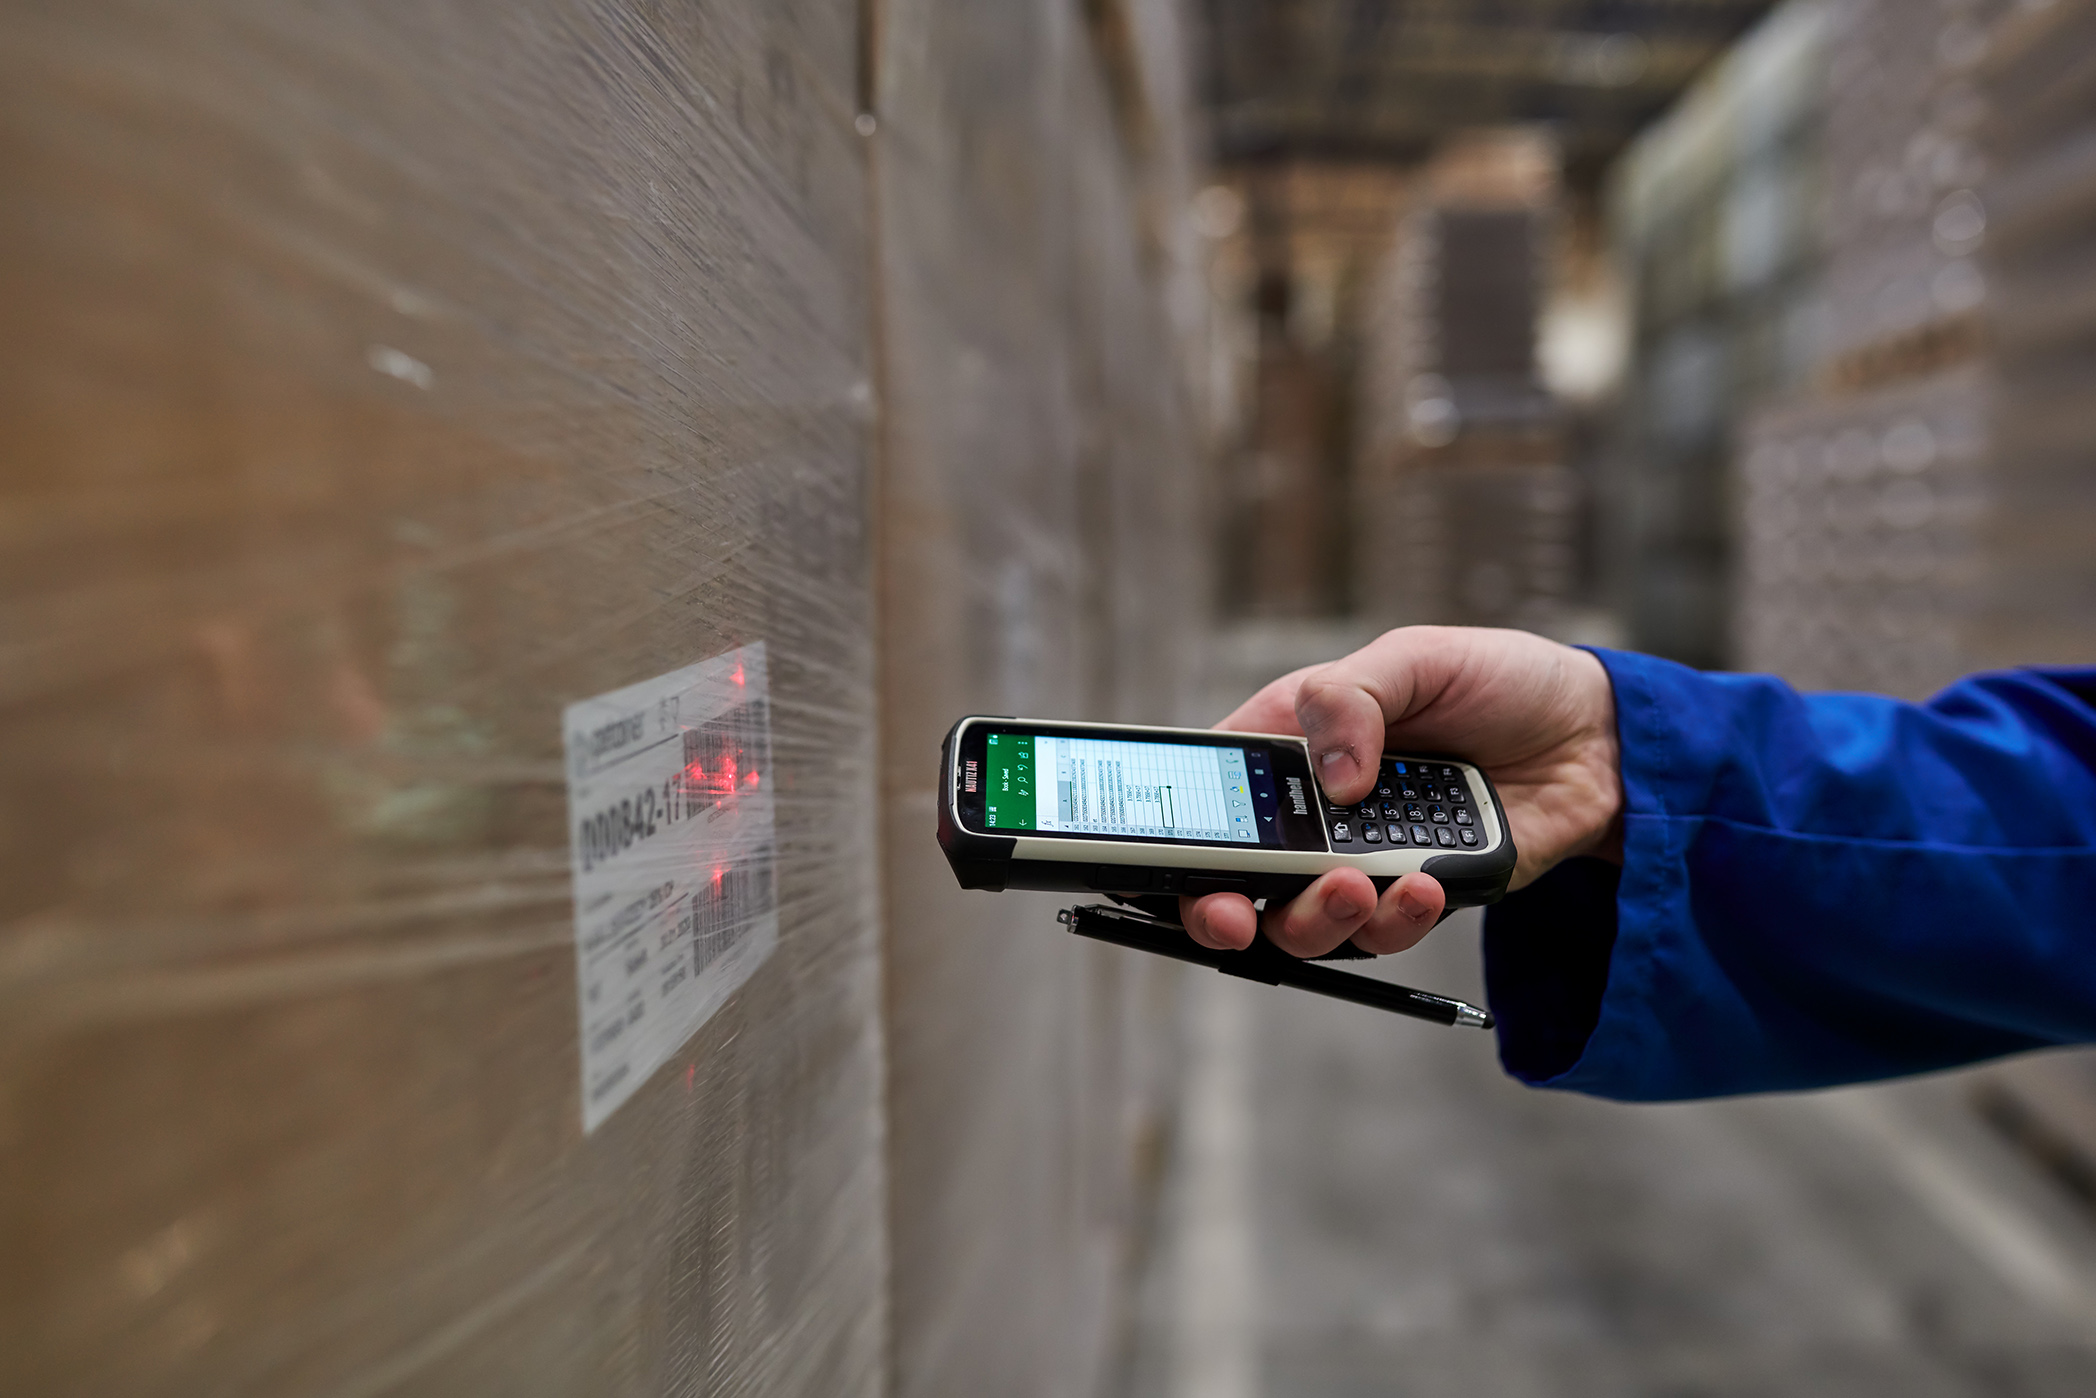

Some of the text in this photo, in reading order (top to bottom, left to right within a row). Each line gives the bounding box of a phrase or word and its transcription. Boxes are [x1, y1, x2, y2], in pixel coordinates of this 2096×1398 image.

[965, 760, 978, 793] NAUTIZ X41
[1286, 777, 1309, 815] handheld
[1450, 787, 1460, 795] F3
[1457, 809, 1467, 817] F2
[989, 814, 997, 827] 14:23
[1464, 830, 1473, 838] F1
